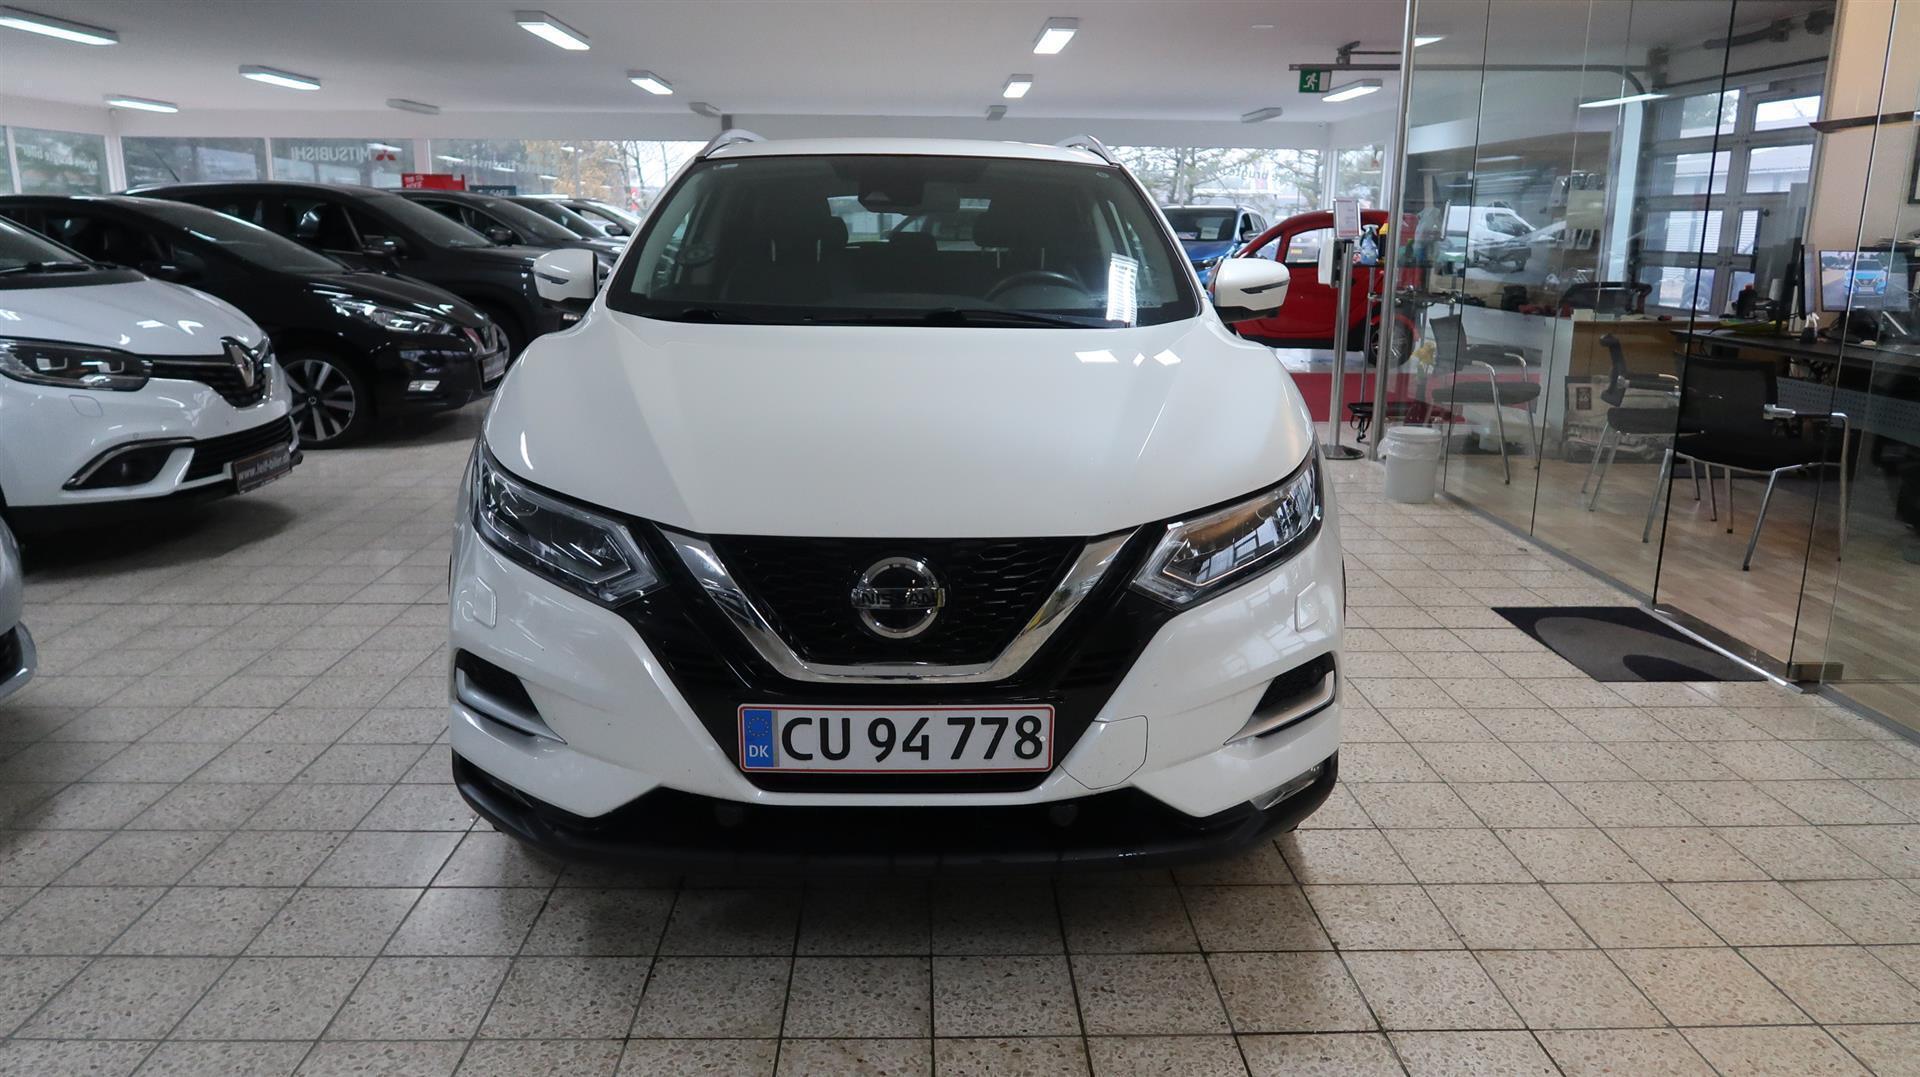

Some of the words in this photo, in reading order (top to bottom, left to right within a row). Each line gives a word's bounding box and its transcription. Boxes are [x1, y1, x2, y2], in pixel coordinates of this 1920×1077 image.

[862, 591, 936, 605] NISAN
[782, 717, 850, 761] CU
[867, 717, 930, 762] 94
[947, 715, 1043, 761] 778
[749, 745, 769, 758] DK
